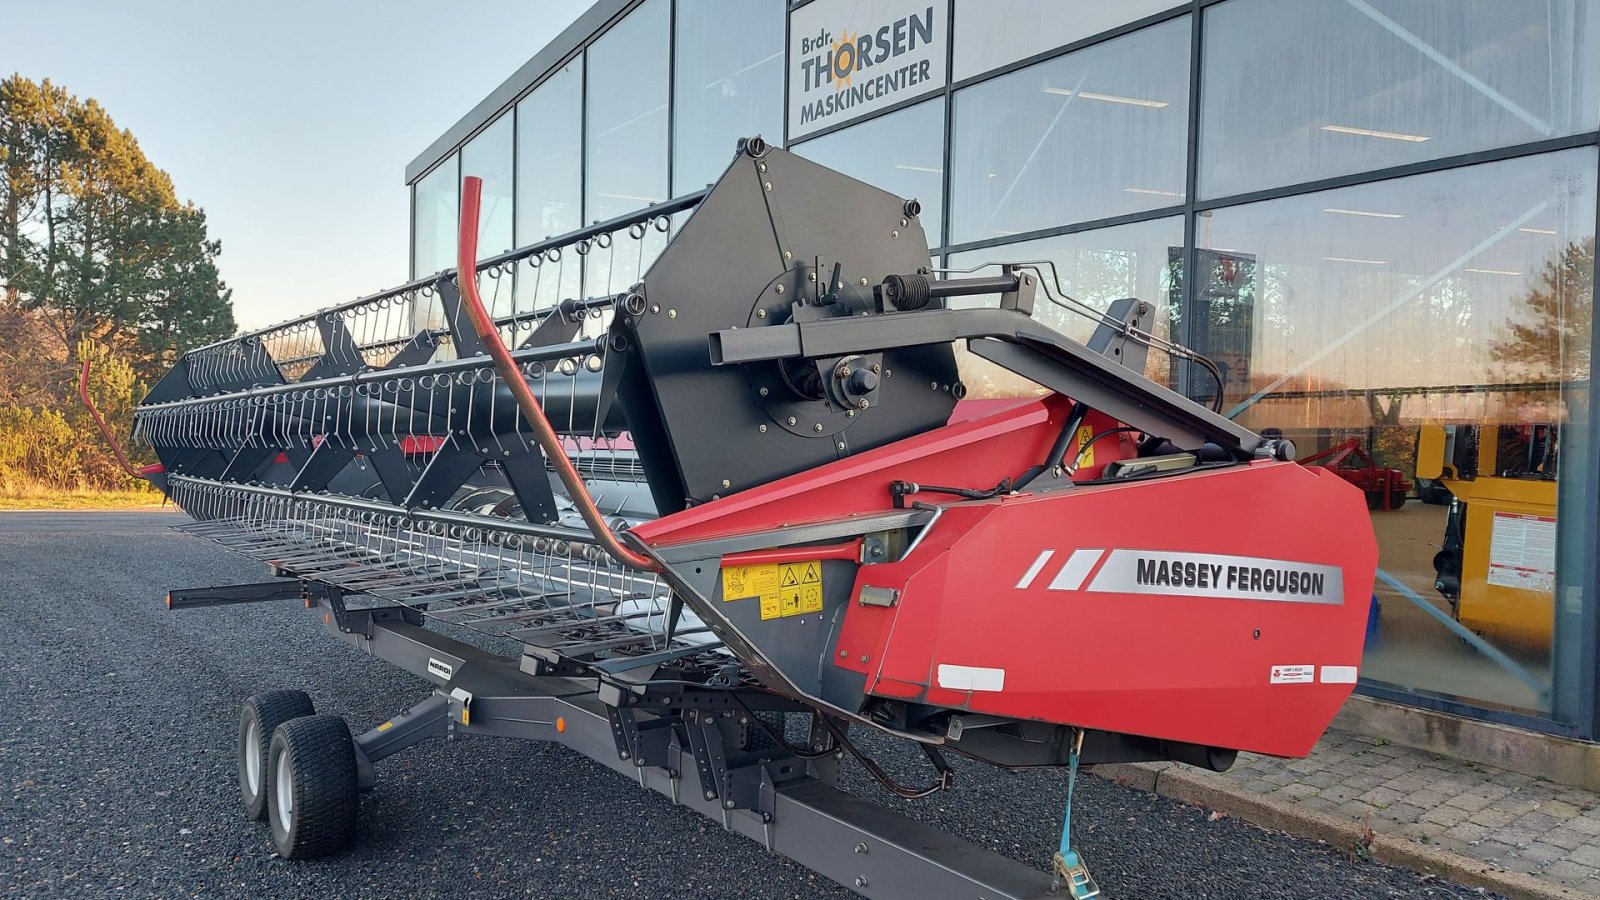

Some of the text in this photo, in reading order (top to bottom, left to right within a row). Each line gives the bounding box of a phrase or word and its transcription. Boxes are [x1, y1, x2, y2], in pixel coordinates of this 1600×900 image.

[801, 28, 833, 56] Brdr.
[801, 6, 933, 93] THORSEN
[800, 59, 931, 126] MASKINCENTER
[1137, 558, 1325, 596] MASSEY FERGUSON
